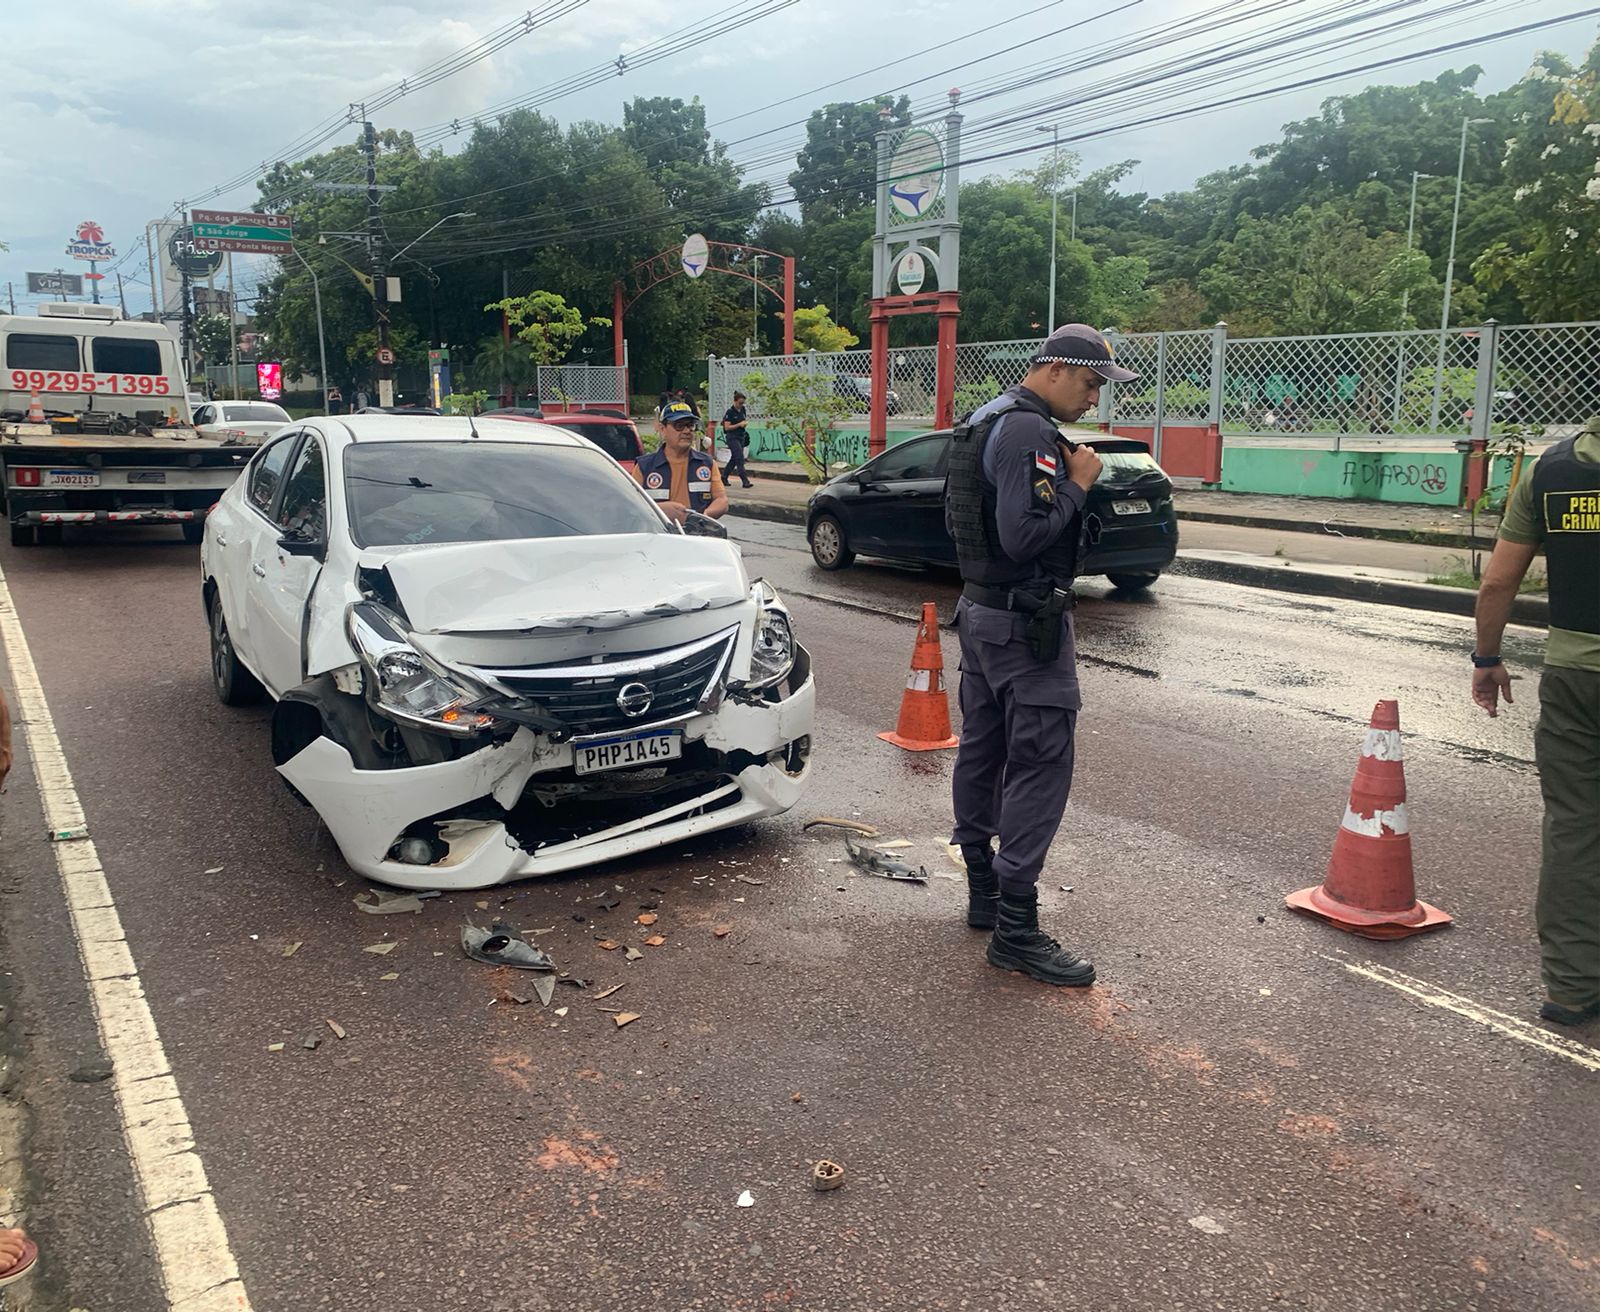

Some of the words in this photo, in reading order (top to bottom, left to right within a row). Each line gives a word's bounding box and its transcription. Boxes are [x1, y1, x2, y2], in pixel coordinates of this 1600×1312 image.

[198, 213, 213, 222] Pq.
[215, 214, 230, 222] dos
[207, 226, 223, 235] São
[225, 228, 249, 238] Jorge
[67, 245, 118, 257] TROPICAL
[220, 241, 234, 249] Pq.
[236, 242, 260, 250] Ponta
[261, 243, 285, 252] Negra
[11, 370, 170, 395] 99295-1395
[584, 737, 670, 769] PHP1A45
